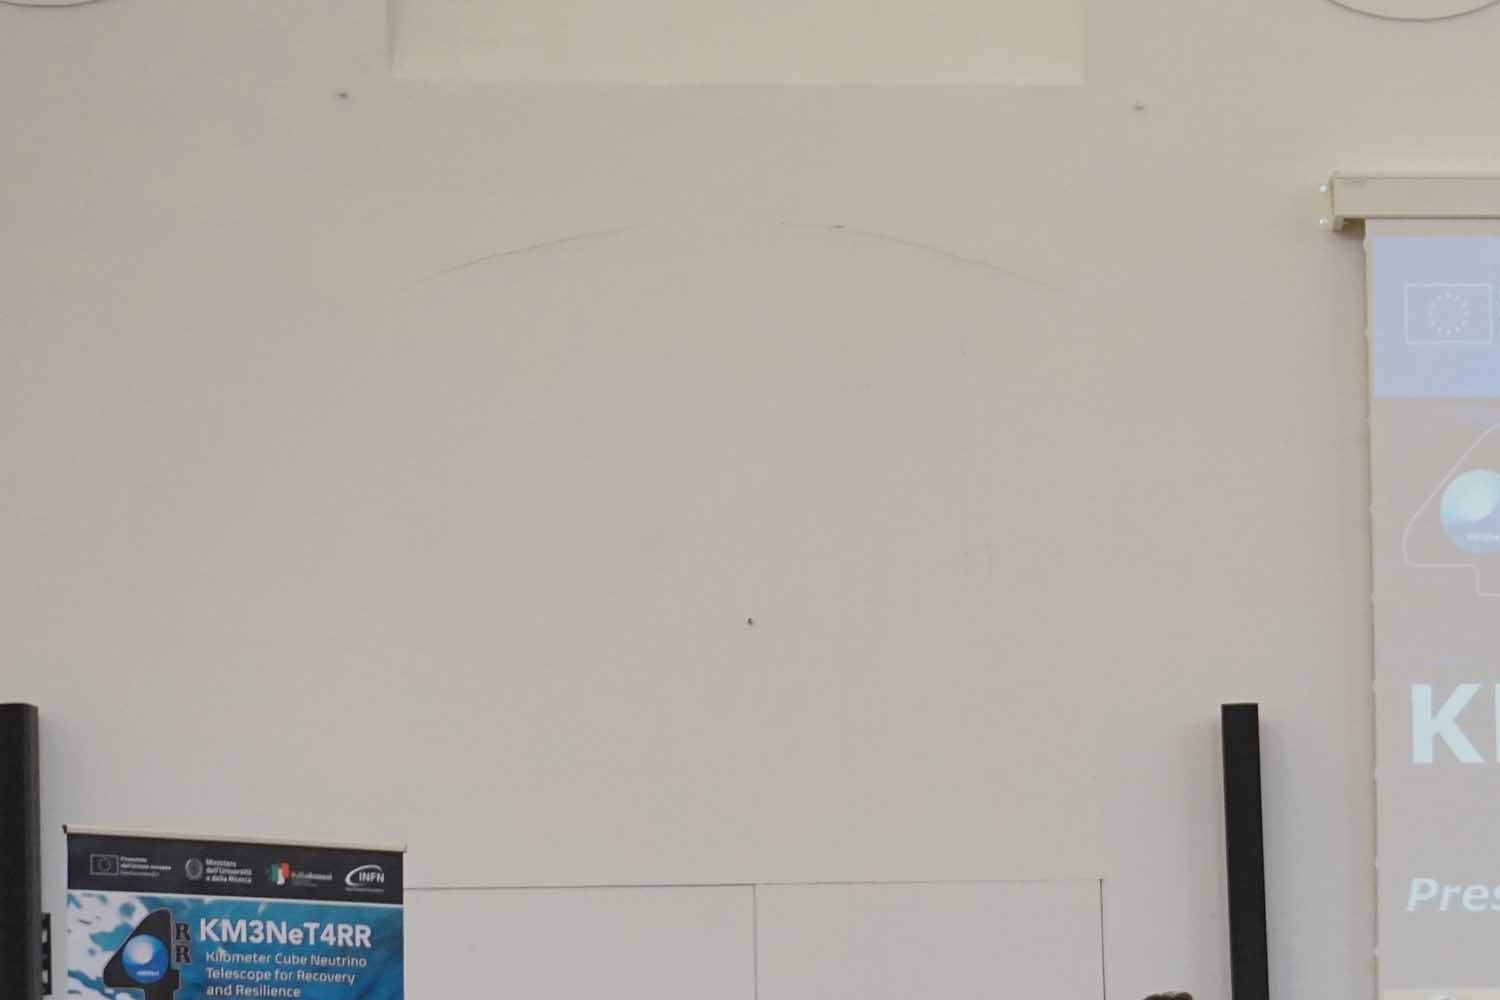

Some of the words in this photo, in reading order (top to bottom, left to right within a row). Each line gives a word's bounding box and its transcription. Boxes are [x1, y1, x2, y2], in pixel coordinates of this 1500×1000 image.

[359, 871, 385, 883] INFN
[200, 917, 372, 948] KM3NeT4RR
[206, 950, 271, 965] Kilometer
[275, 952, 307, 966] Cube
[310, 953, 368, 968] Neutrino
[206, 967, 271, 983] Telescope
[274, 968, 293, 982] for
[296, 969, 356, 986] Recovery
[206, 984, 232, 997] and
[235, 985, 301, 999] Resilience
